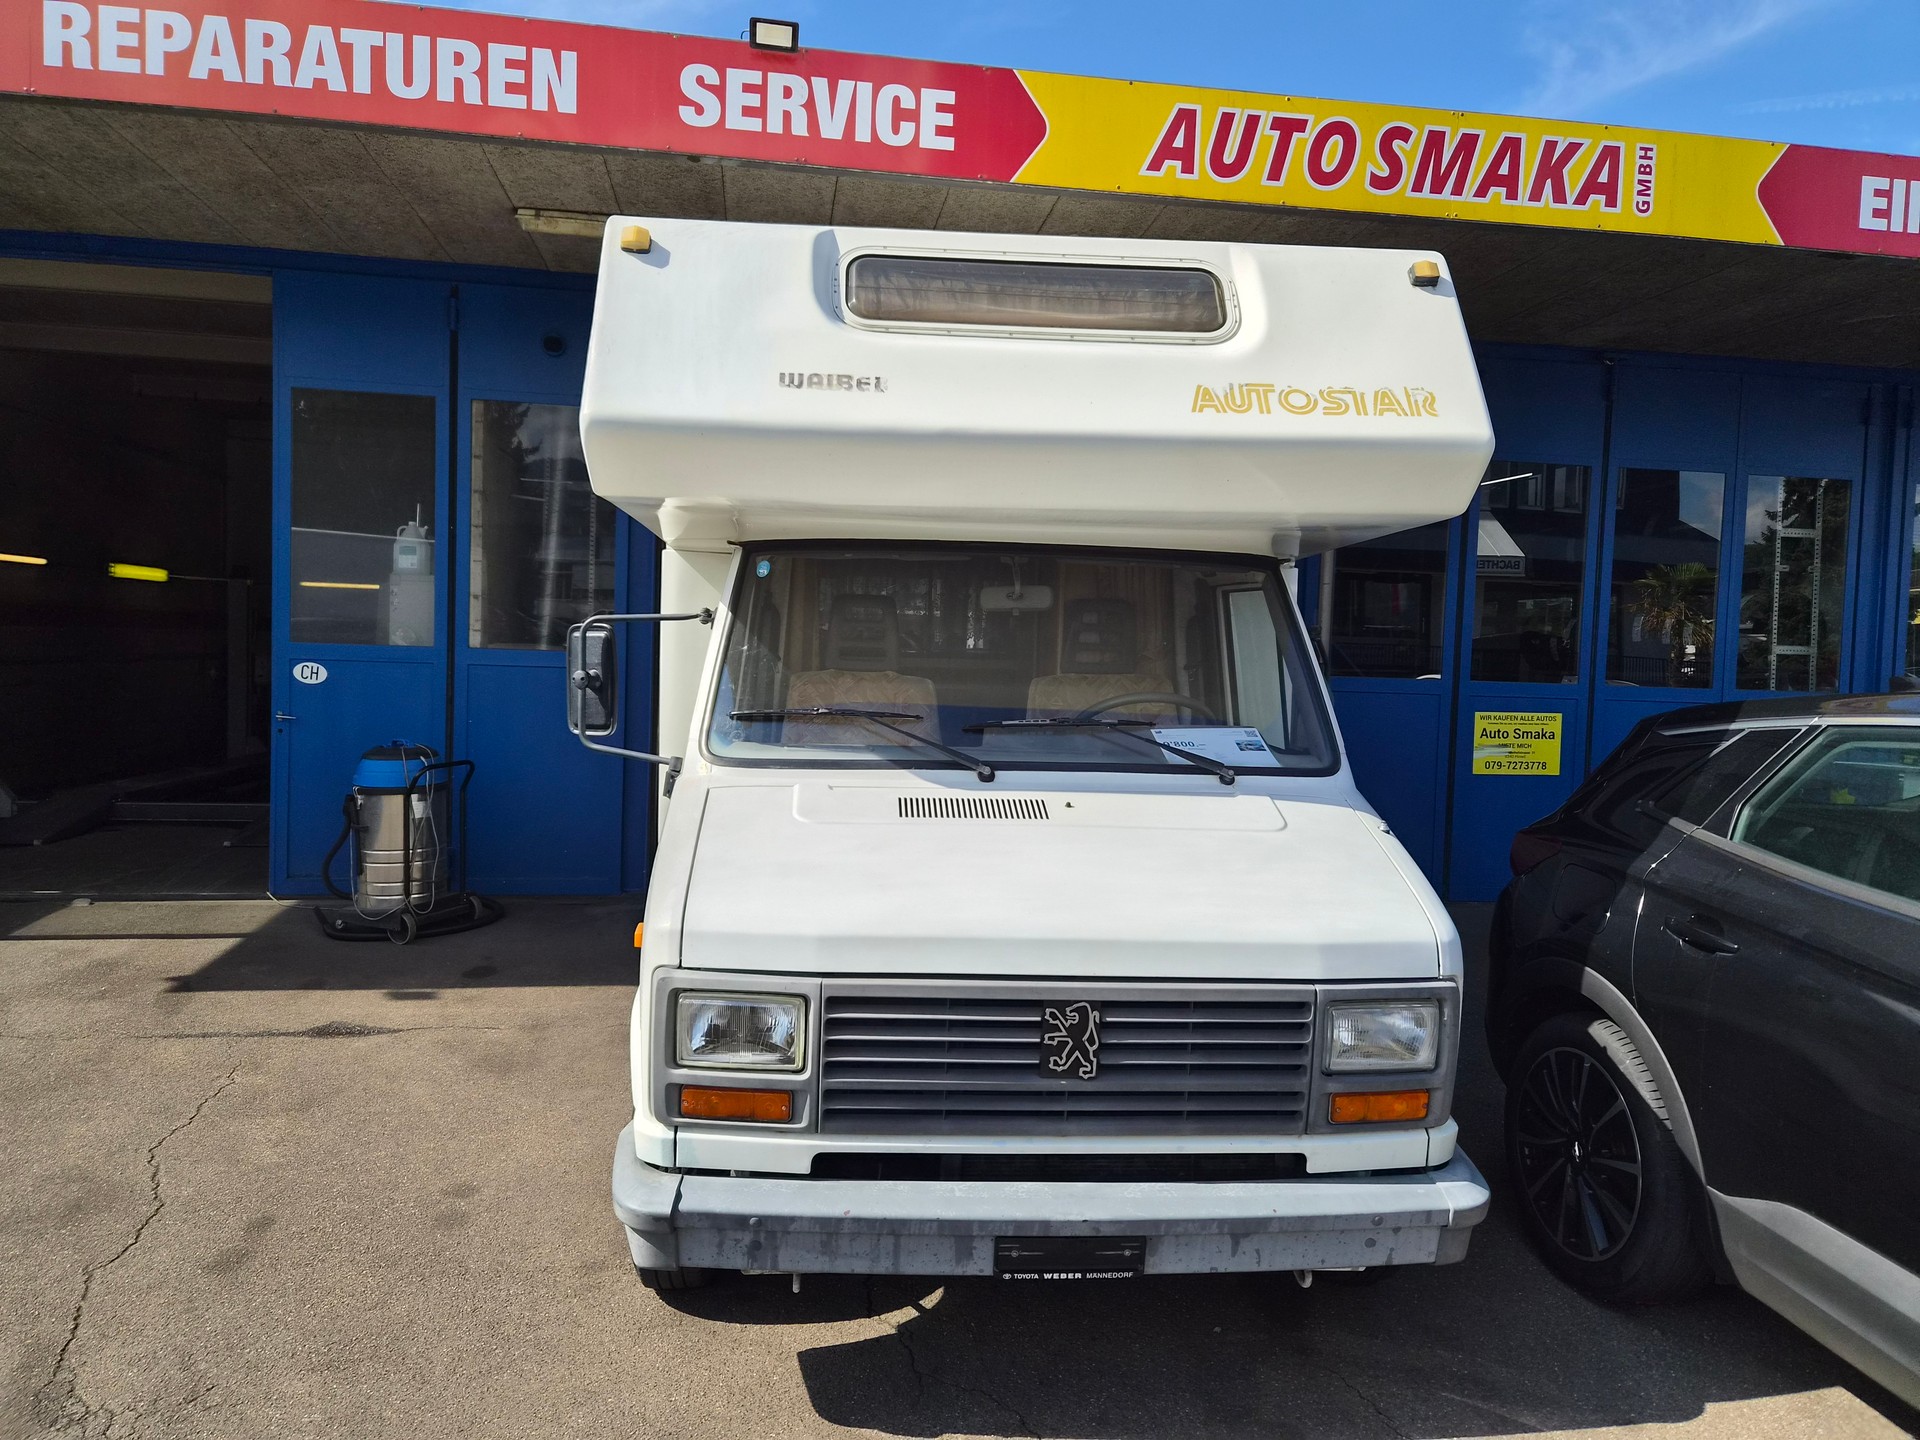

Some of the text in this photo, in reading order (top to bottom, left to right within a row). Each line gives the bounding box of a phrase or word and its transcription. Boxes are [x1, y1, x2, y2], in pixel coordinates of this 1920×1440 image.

[42, 0, 578, 115] REPARATUREN
[678, 63, 956, 152] SERVICE
[1139, 102, 1624, 214] AUTO SMAKA
[1634, 144, 1656, 216] GMBH
[1191, 383, 1439, 417] AUTOSTAR
[301, 665, 319, 680] CH
[1480, 728, 1555, 740] Auto Smaka
[1484, 760, 1547, 770] 079-7273778
